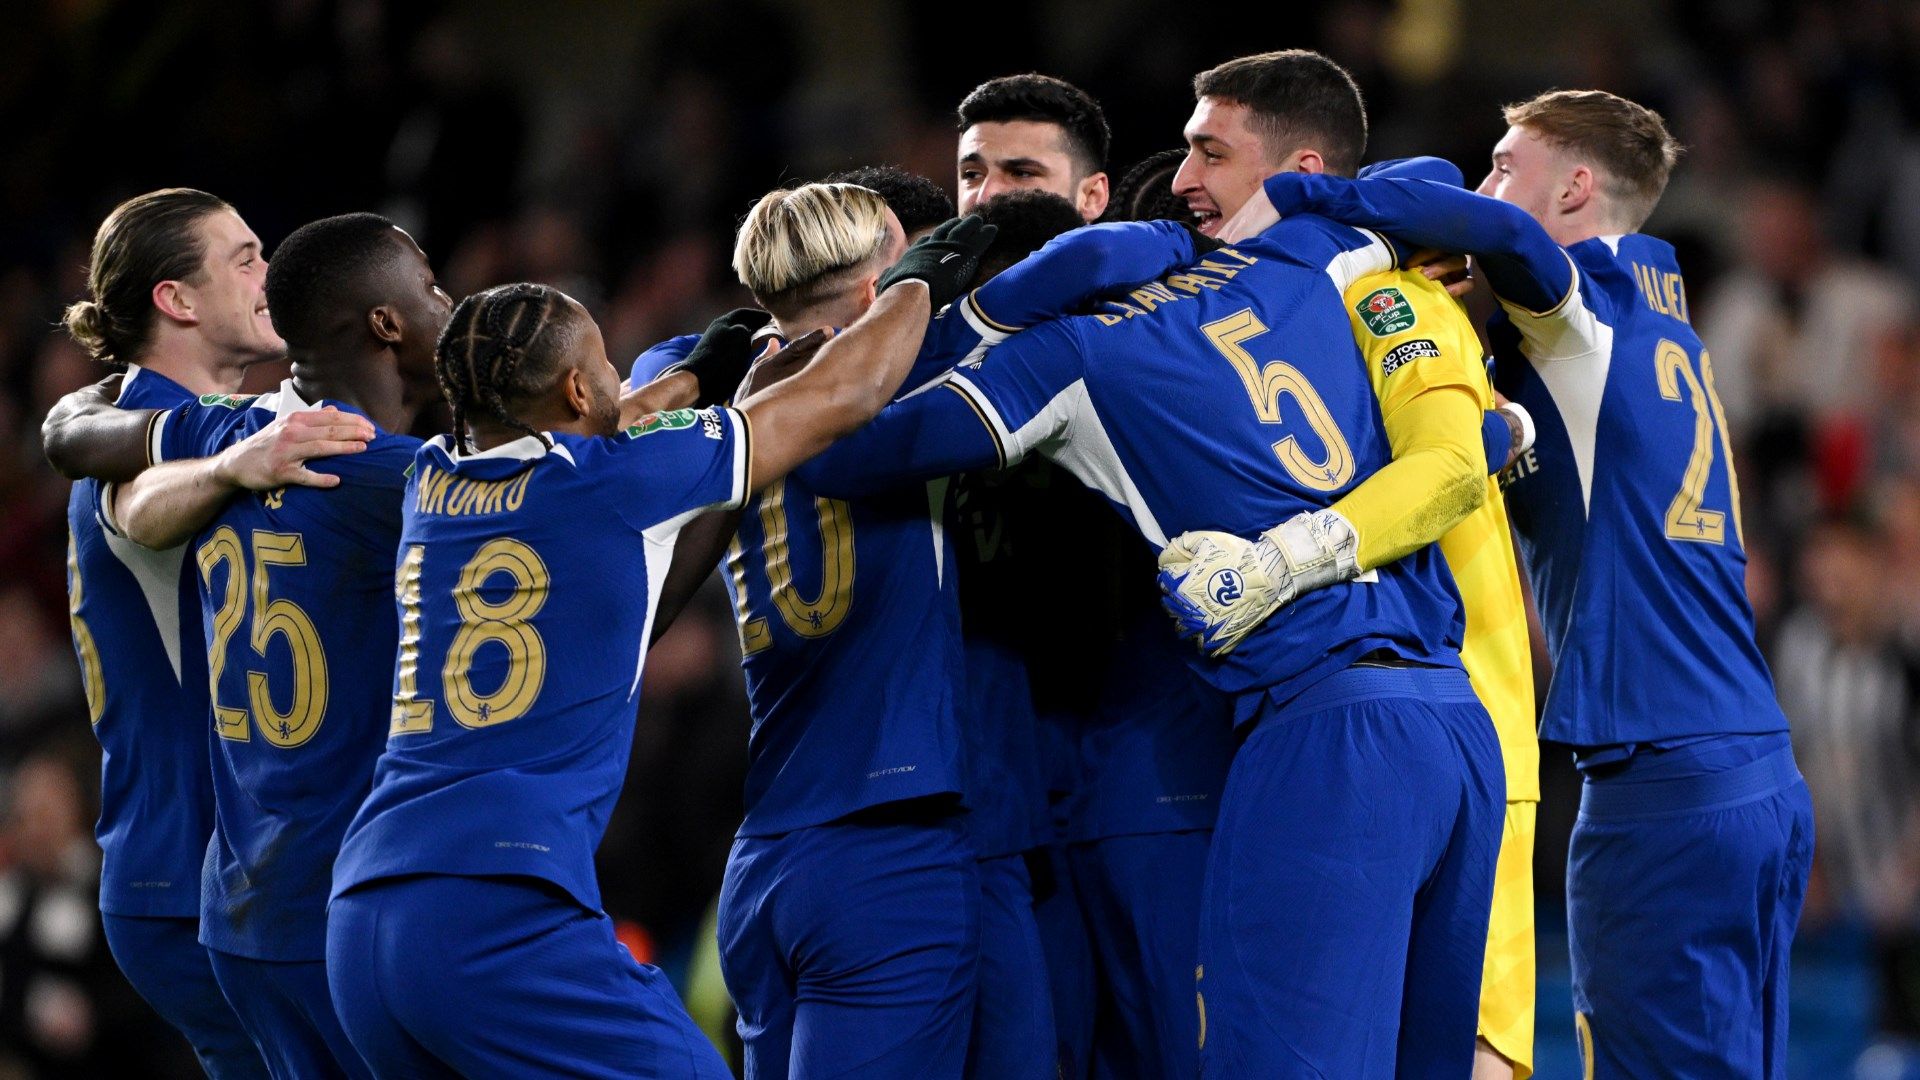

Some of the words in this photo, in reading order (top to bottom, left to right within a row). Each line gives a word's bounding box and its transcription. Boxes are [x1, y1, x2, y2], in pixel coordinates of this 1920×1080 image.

[1369, 301, 1407, 326] Carabao
[1381, 310, 1400, 323] Cup
[1396, 341, 1432, 356] room
[1200, 307, 1356, 491] 5
[1654, 337, 1745, 554] 2
[415, 464, 535, 516] NKUNKU
[1216, 571, 1242, 607] RG
[197, 525, 329, 748] 25
[388, 537, 550, 737] 18
